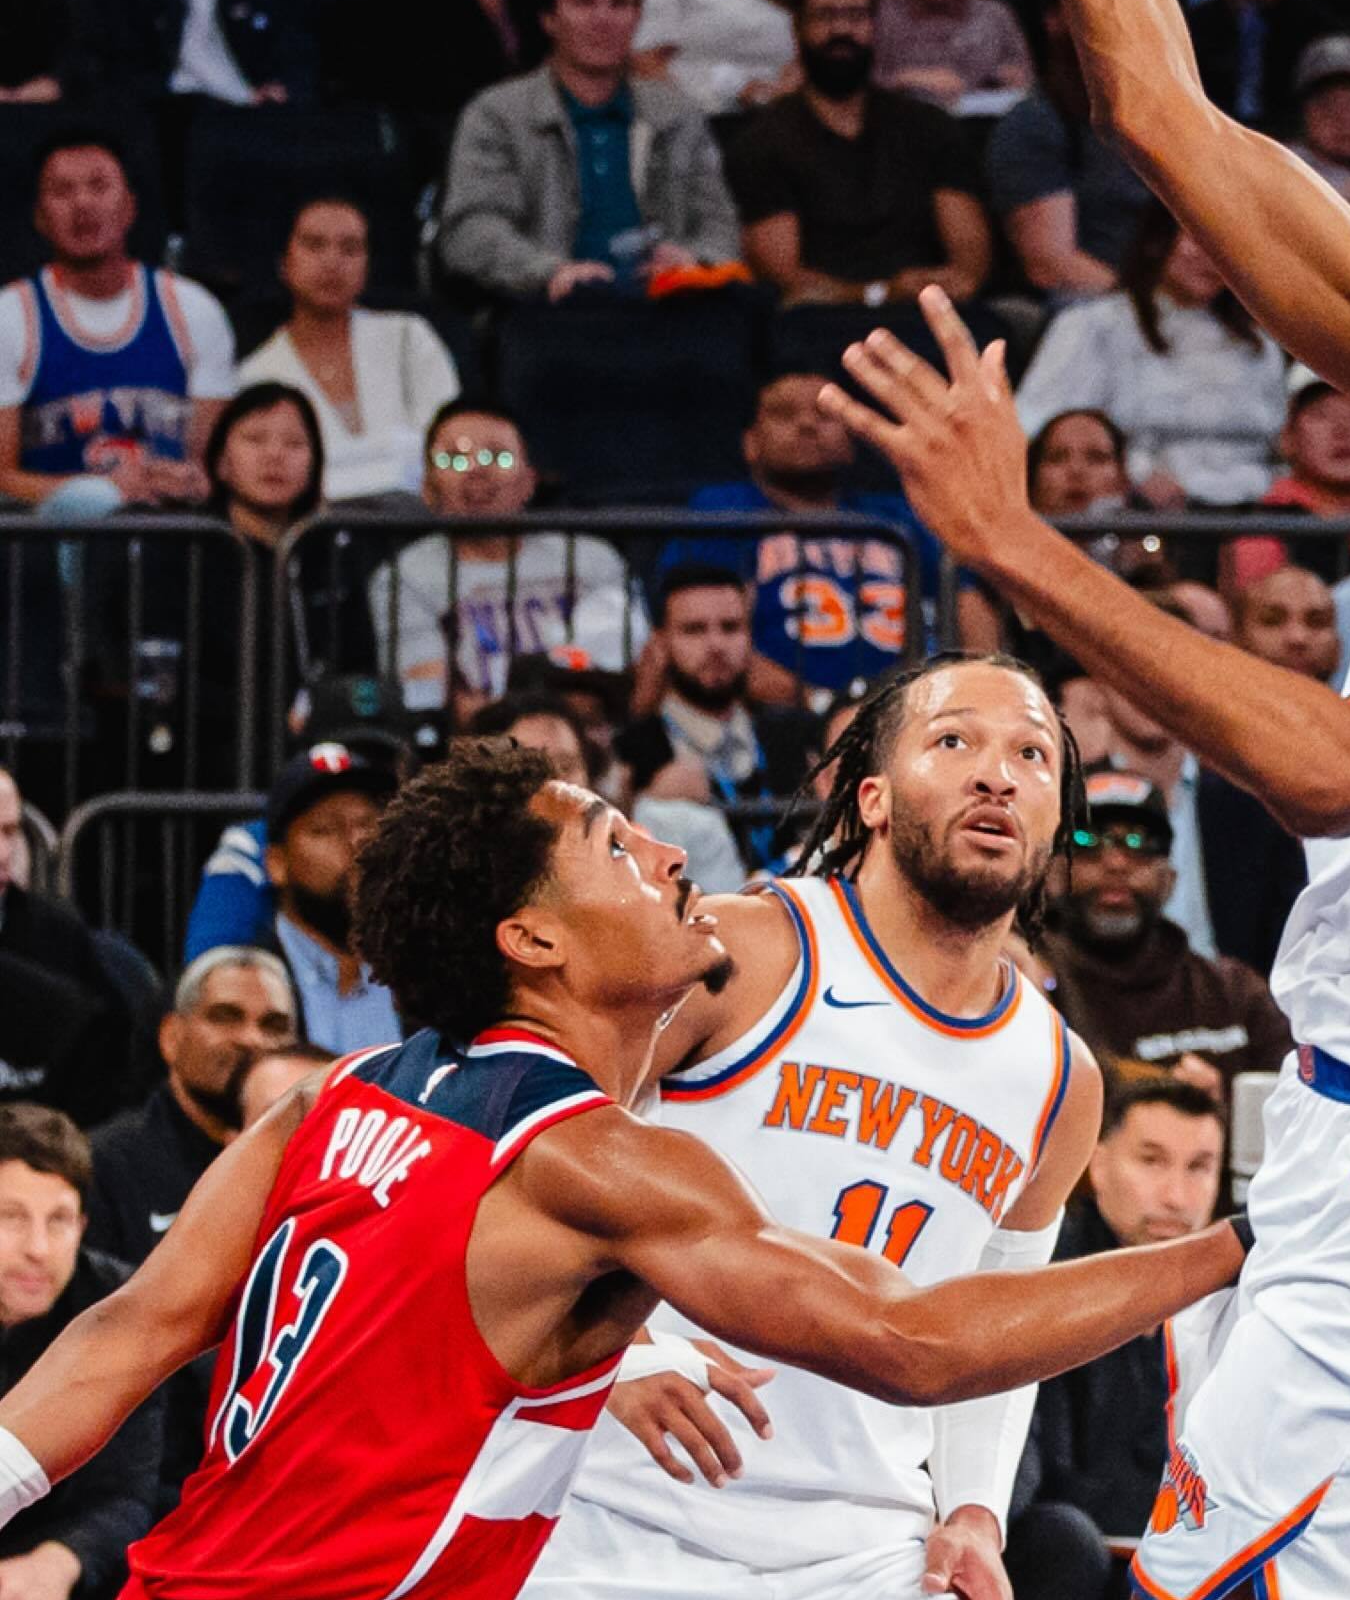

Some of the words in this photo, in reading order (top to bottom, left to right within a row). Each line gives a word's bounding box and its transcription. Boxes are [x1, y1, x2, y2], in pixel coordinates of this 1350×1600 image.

[761, 1060, 918, 1151] NEW
[911, 1090, 1025, 1228] YORK
[207, 1216, 350, 1471] 13
